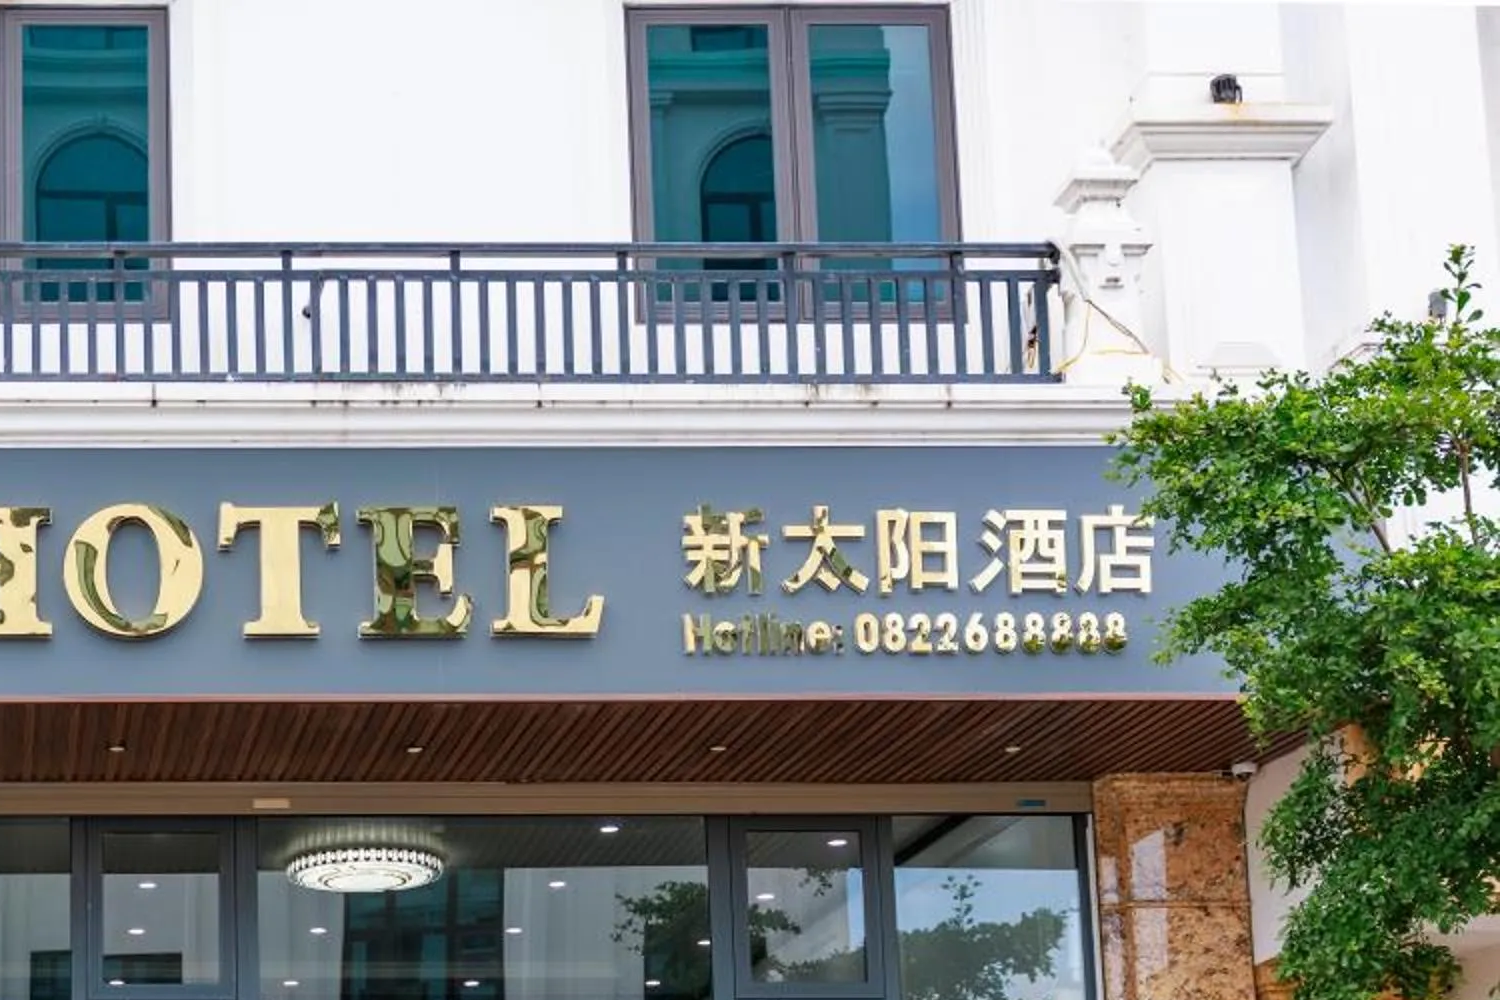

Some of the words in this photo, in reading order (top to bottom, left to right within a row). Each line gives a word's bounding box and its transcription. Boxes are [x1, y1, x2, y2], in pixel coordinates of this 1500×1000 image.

[680, 504, 1156, 596] 新太阳酒店
[681, 611, 846, 656] Hotline:
[852, 610, 1130, 656] 0822688888
